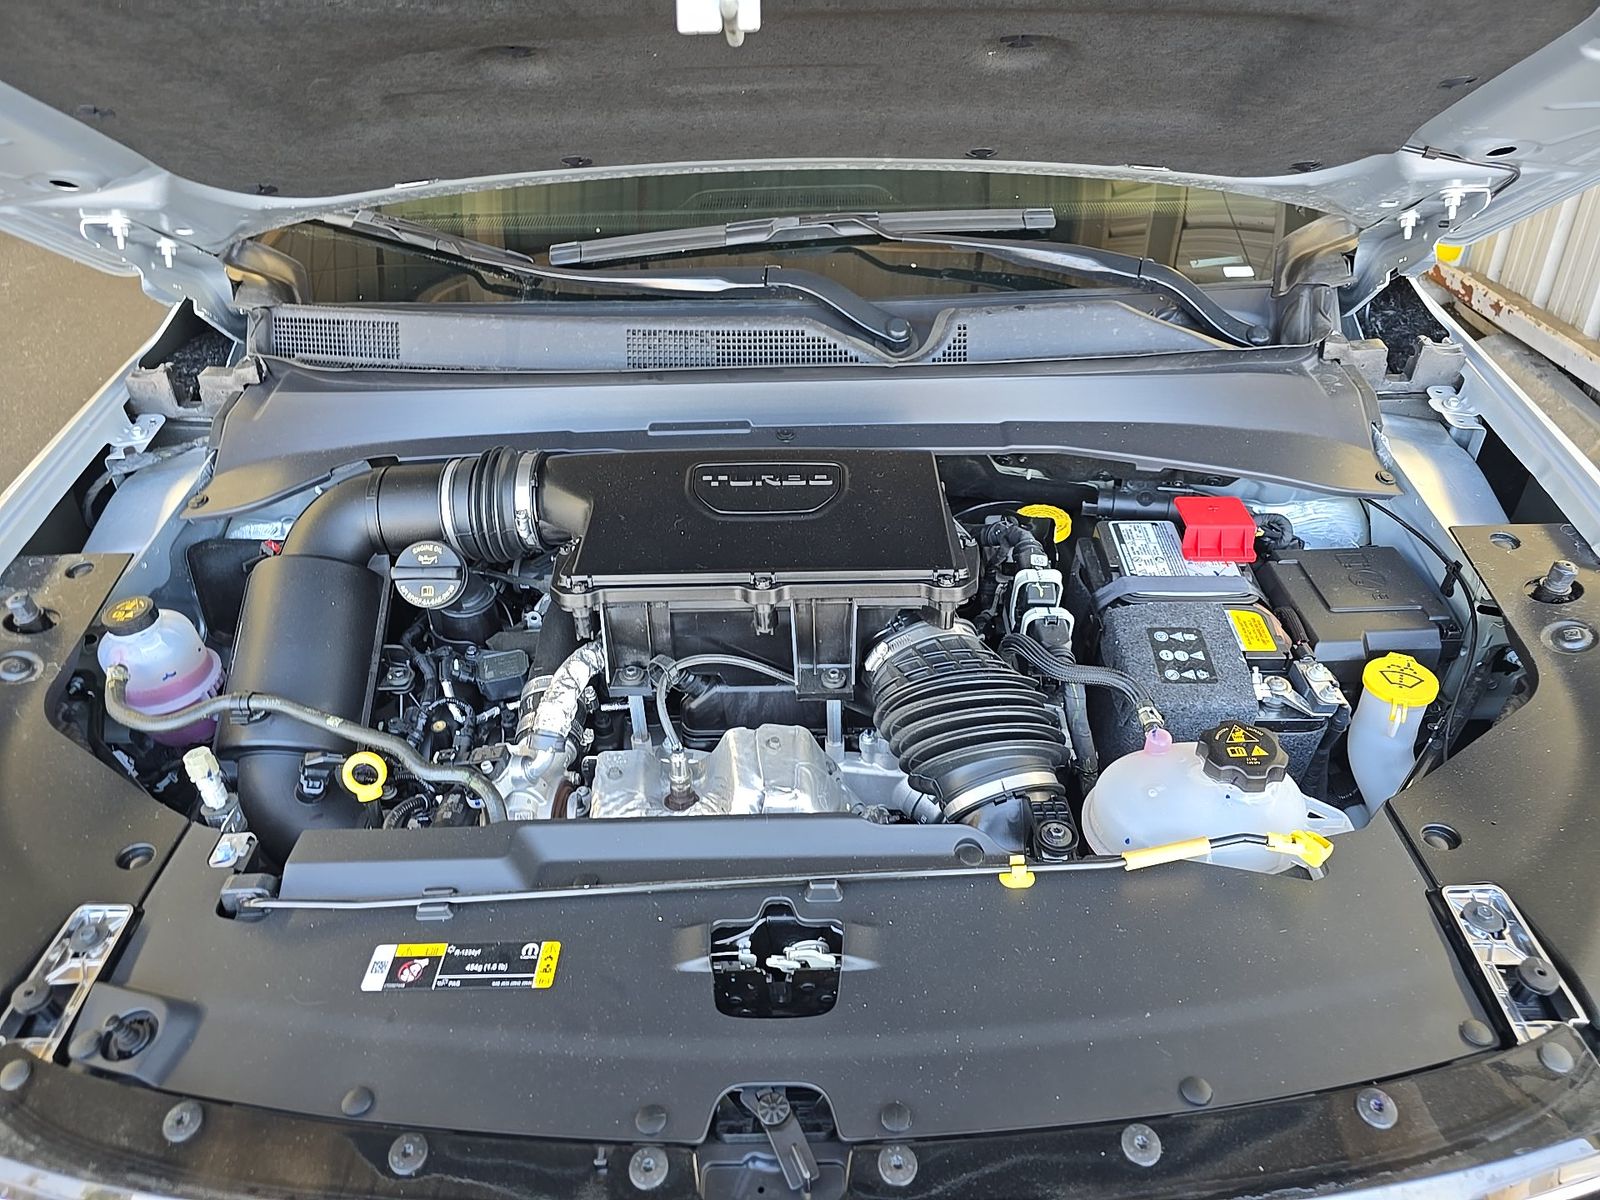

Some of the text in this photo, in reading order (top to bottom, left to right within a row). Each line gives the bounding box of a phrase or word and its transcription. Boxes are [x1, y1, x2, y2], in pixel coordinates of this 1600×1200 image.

[702, 474, 834, 487] TURBO
[412, 544, 443, 555] ENGINE OIL
